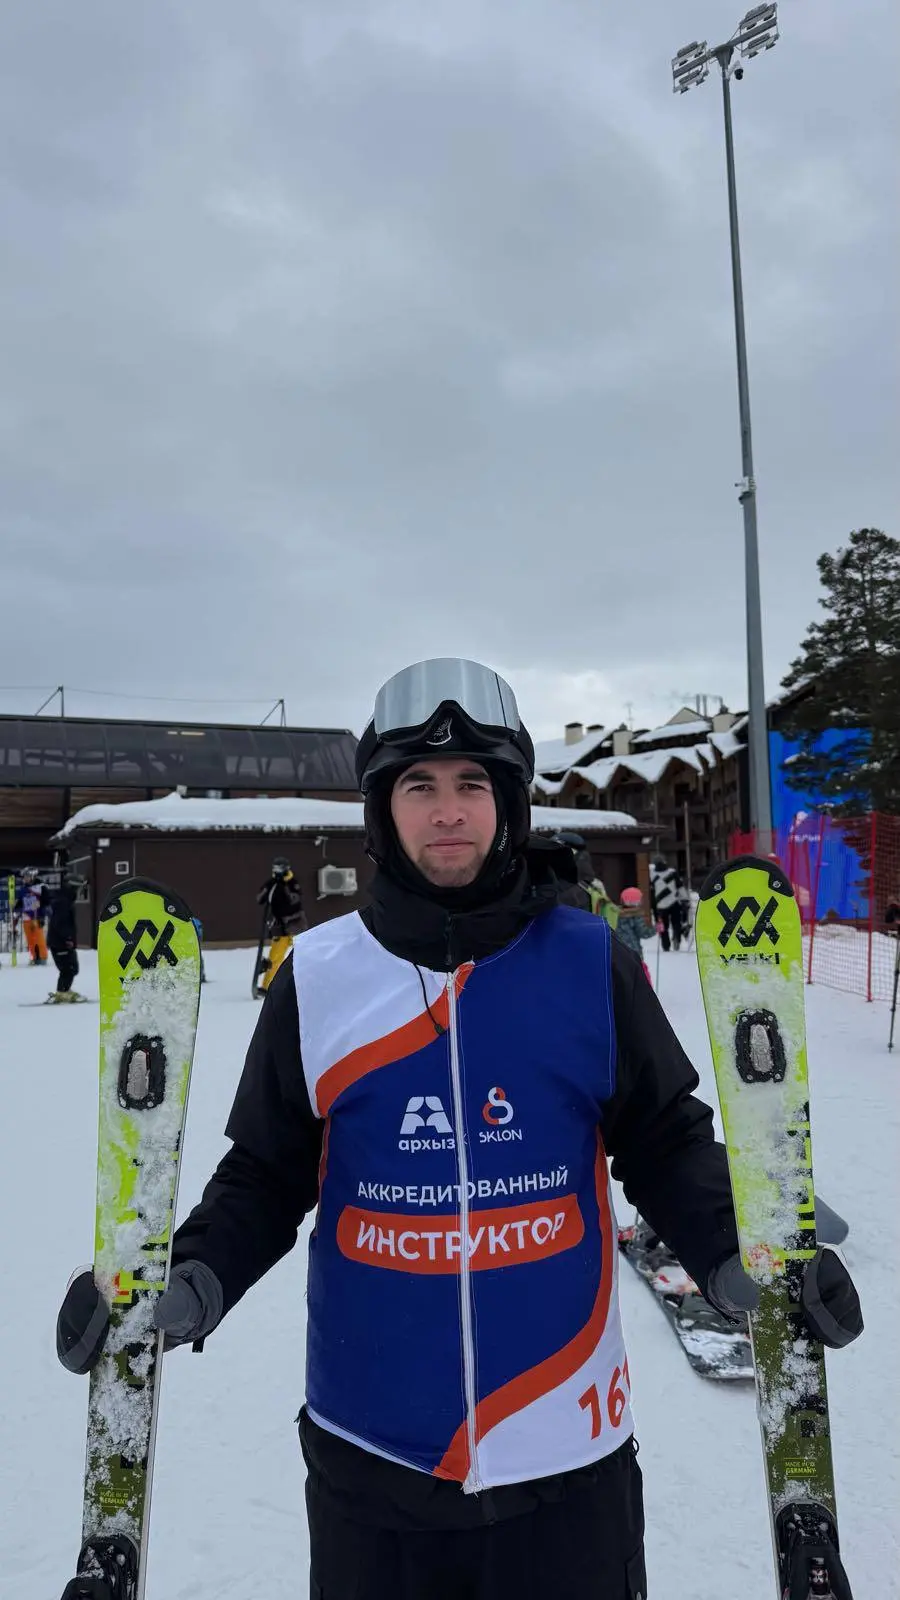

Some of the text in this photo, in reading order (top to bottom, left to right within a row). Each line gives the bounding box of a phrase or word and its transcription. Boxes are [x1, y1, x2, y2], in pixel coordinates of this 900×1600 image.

[478, 1128, 523, 1143] SKLON
[398, 1138, 456, 1153] архыз
[356, 1212, 566, 1260] ИНСТРУКТОР
